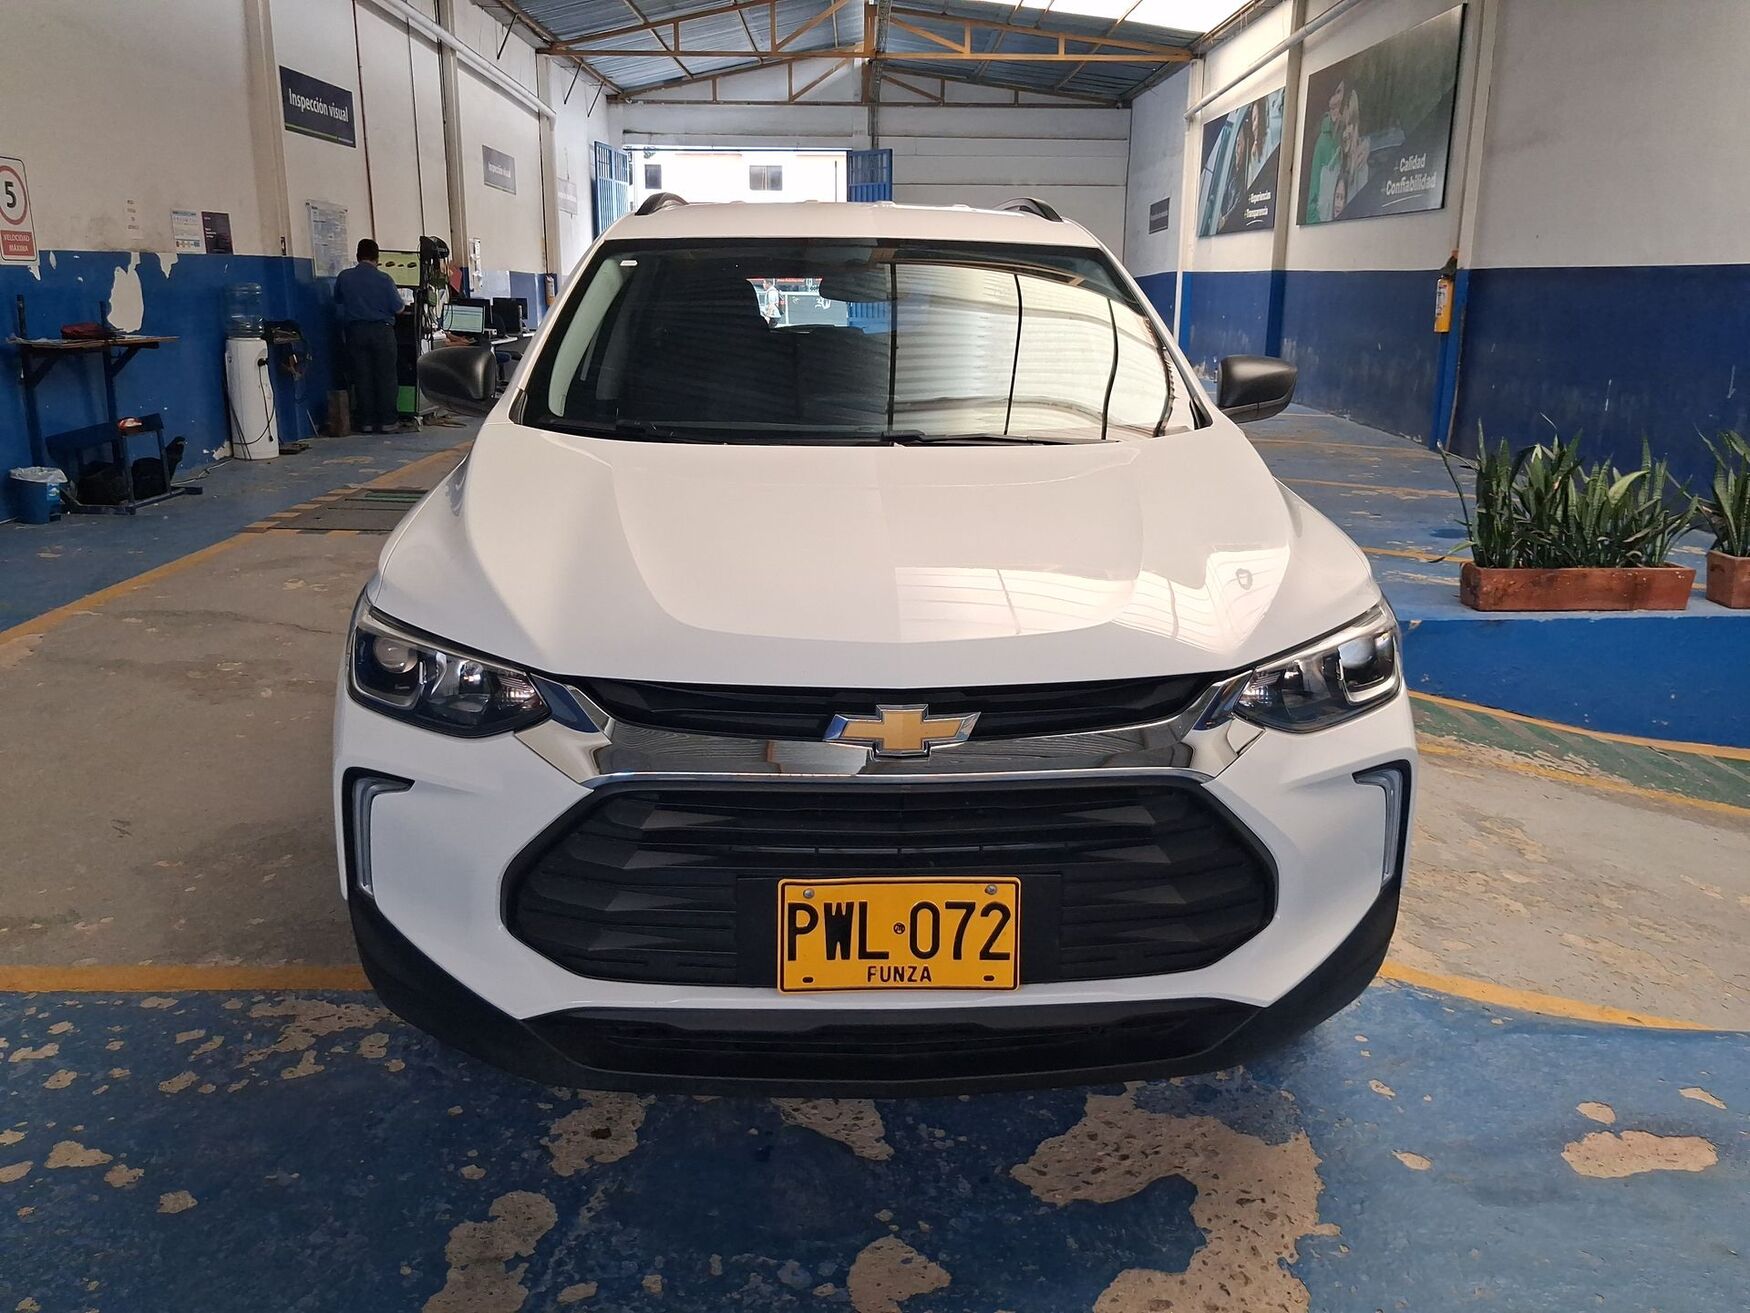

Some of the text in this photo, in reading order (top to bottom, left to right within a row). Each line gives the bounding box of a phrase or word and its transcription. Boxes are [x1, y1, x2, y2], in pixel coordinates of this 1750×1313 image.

[288, 87, 349, 123] Inspección visual
[1400, 153, 1426, 172] Calidad
[5, 181, 17, 208] 5
[787, 901, 1011, 961] PWL 072
[867, 965, 932, 983] FUNZA
